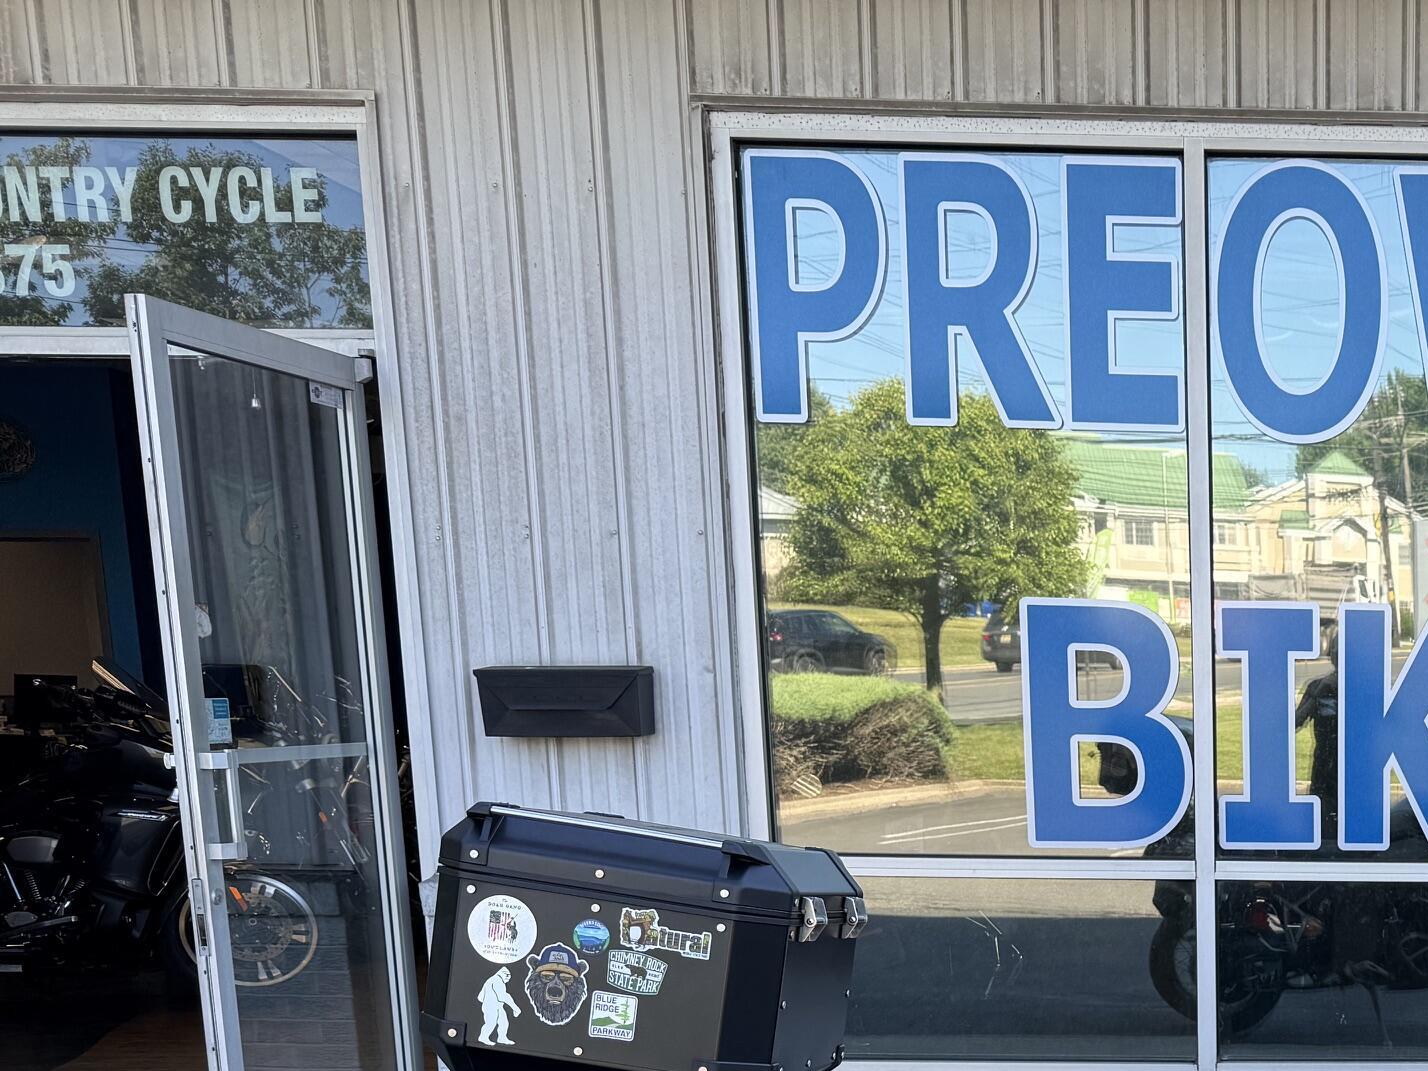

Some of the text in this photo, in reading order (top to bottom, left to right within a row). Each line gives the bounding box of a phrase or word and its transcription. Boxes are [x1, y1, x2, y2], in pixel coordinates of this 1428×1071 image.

[0, 165, 322, 224] NTRY CYCLE
[0, 244, 76, 297] 75
[610, 951, 646, 967] CHIMNEY
[646, 957, 667, 973] ROCK
[609, 970, 660, 992] STATE PARK
[595, 1003, 620, 1013] RIDGE
[596, 994, 617, 1004] BLUE
[592, 1026, 631, 1037] PARKWAY
